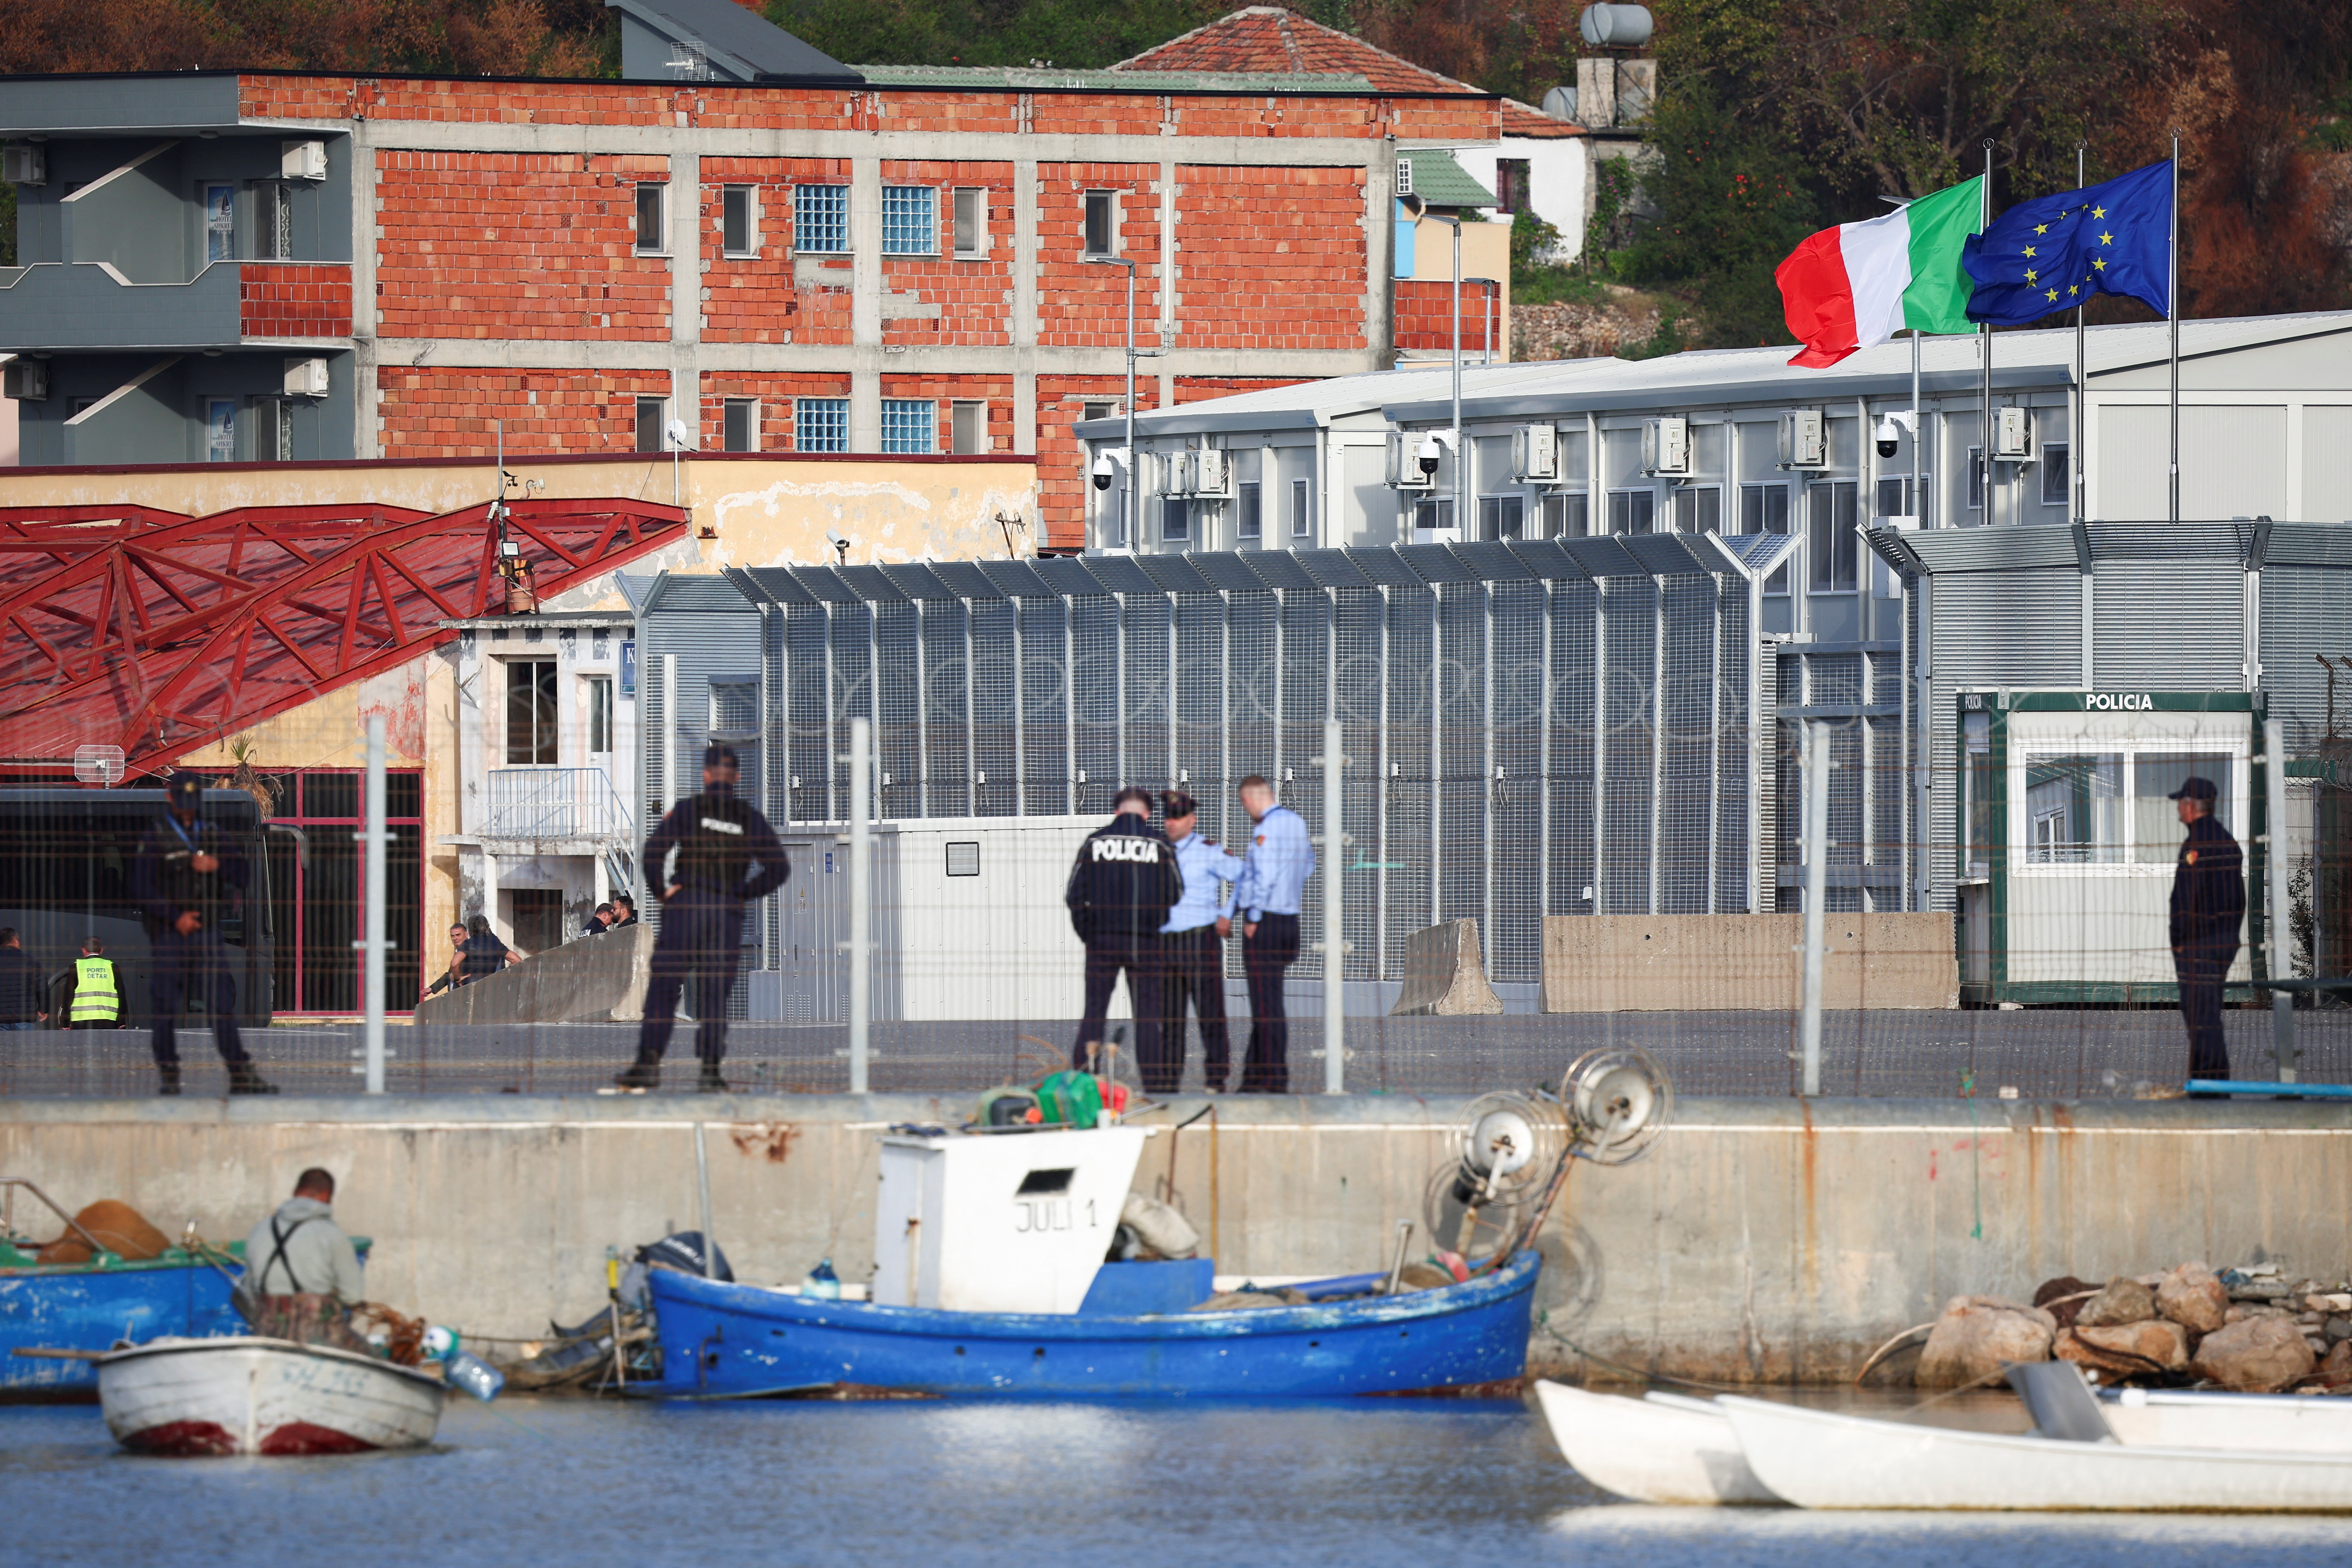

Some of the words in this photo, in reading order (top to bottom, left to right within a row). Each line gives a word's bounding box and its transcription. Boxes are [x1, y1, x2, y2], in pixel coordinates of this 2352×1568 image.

[1965, 694, 1982, 709] POLICIA
[2086, 694, 2153, 710] POLICIA
[1092, 839, 1158, 863] POLICIA
[1015, 1199, 1072, 1232] JULI
[1085, 1199, 1098, 1227] 1
